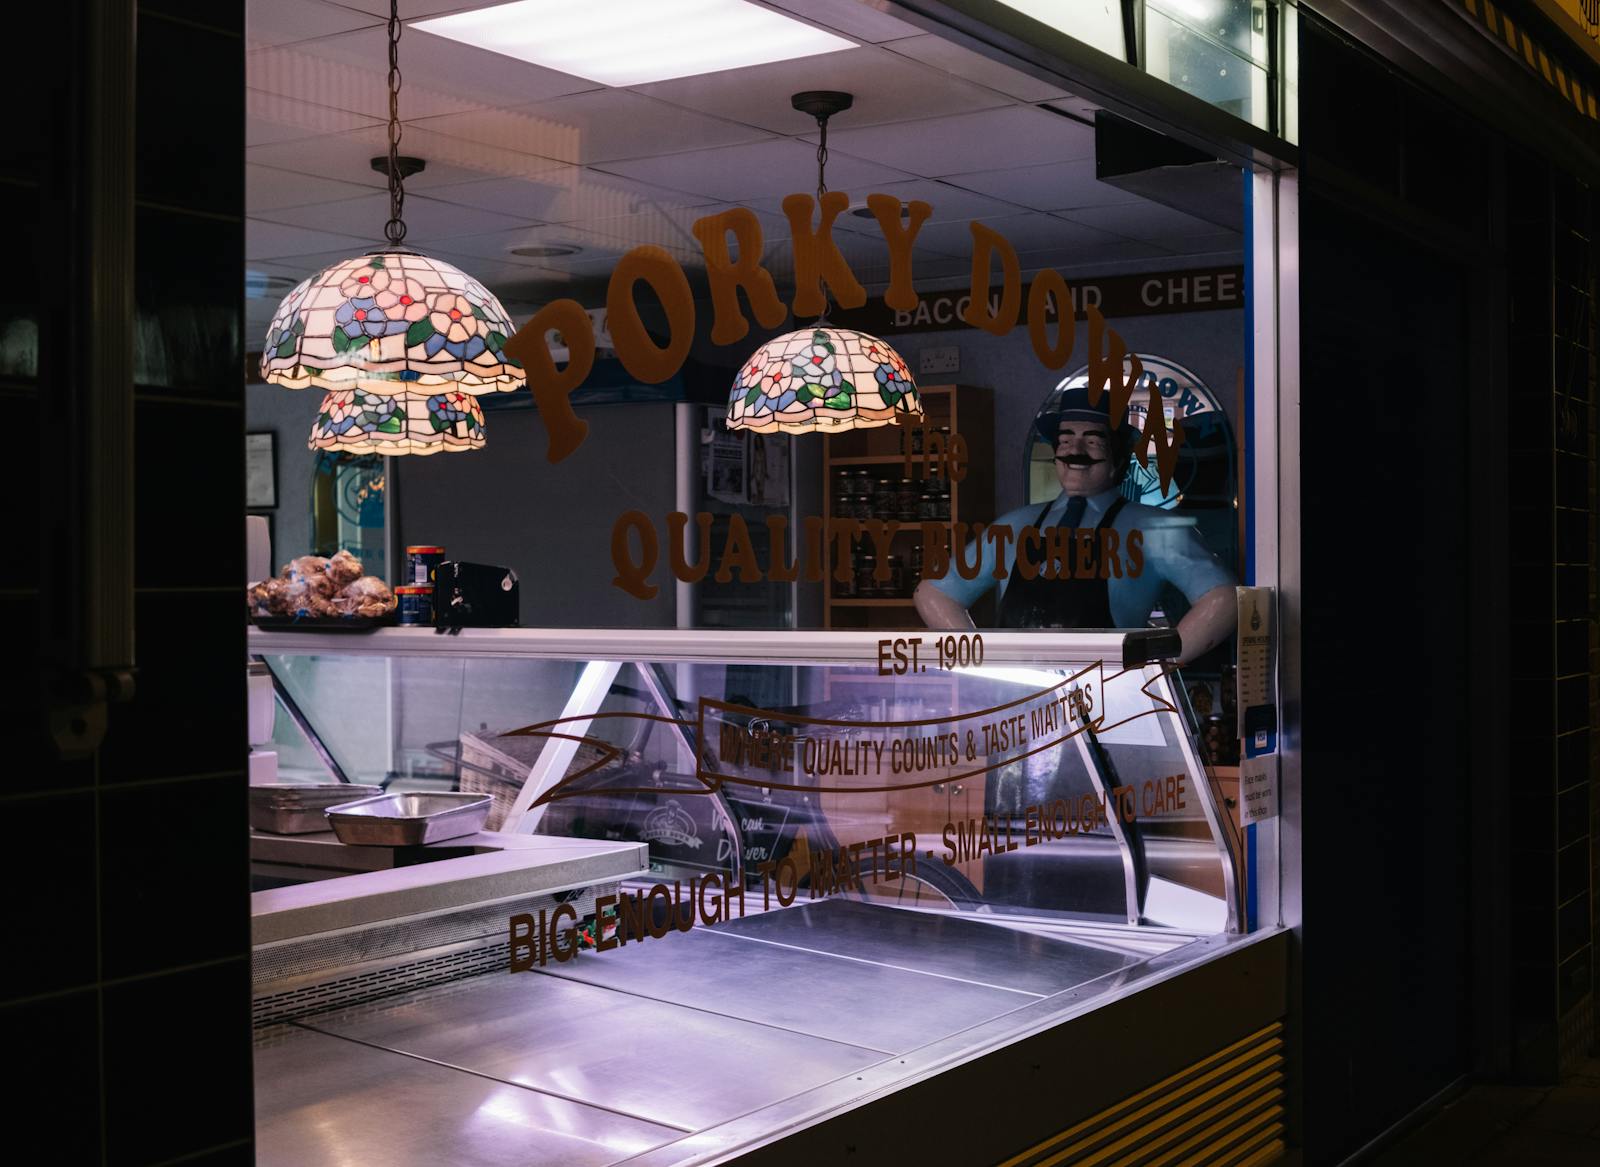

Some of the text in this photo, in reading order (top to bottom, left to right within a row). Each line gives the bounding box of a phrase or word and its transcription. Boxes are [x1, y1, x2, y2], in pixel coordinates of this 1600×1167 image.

[1141, 272, 1245, 308] CHEE
[502, 192, 1185, 499] PORKY DOWN
[896, 414, 968, 482] The
[611, 510, 1145, 600] QUALITY BUTCHERS
[878, 633, 984, 676] EST. 1900
[719, 682, 1094, 777] WHERE QUALITY COUNTS & TASTE MATTERS
[510, 903, 578, 974] BIG
[596, 867, 745, 953] ENOUGH
[757, 858, 798, 911] TO
[809, 832, 917, 900] MATTER
[942, 813, 1018, 866] SMALL
[1025, 788, 1106, 847] ENOUGH
[1112, 783, 1137, 825] TO
[1142, 774, 1186, 817] CARE
